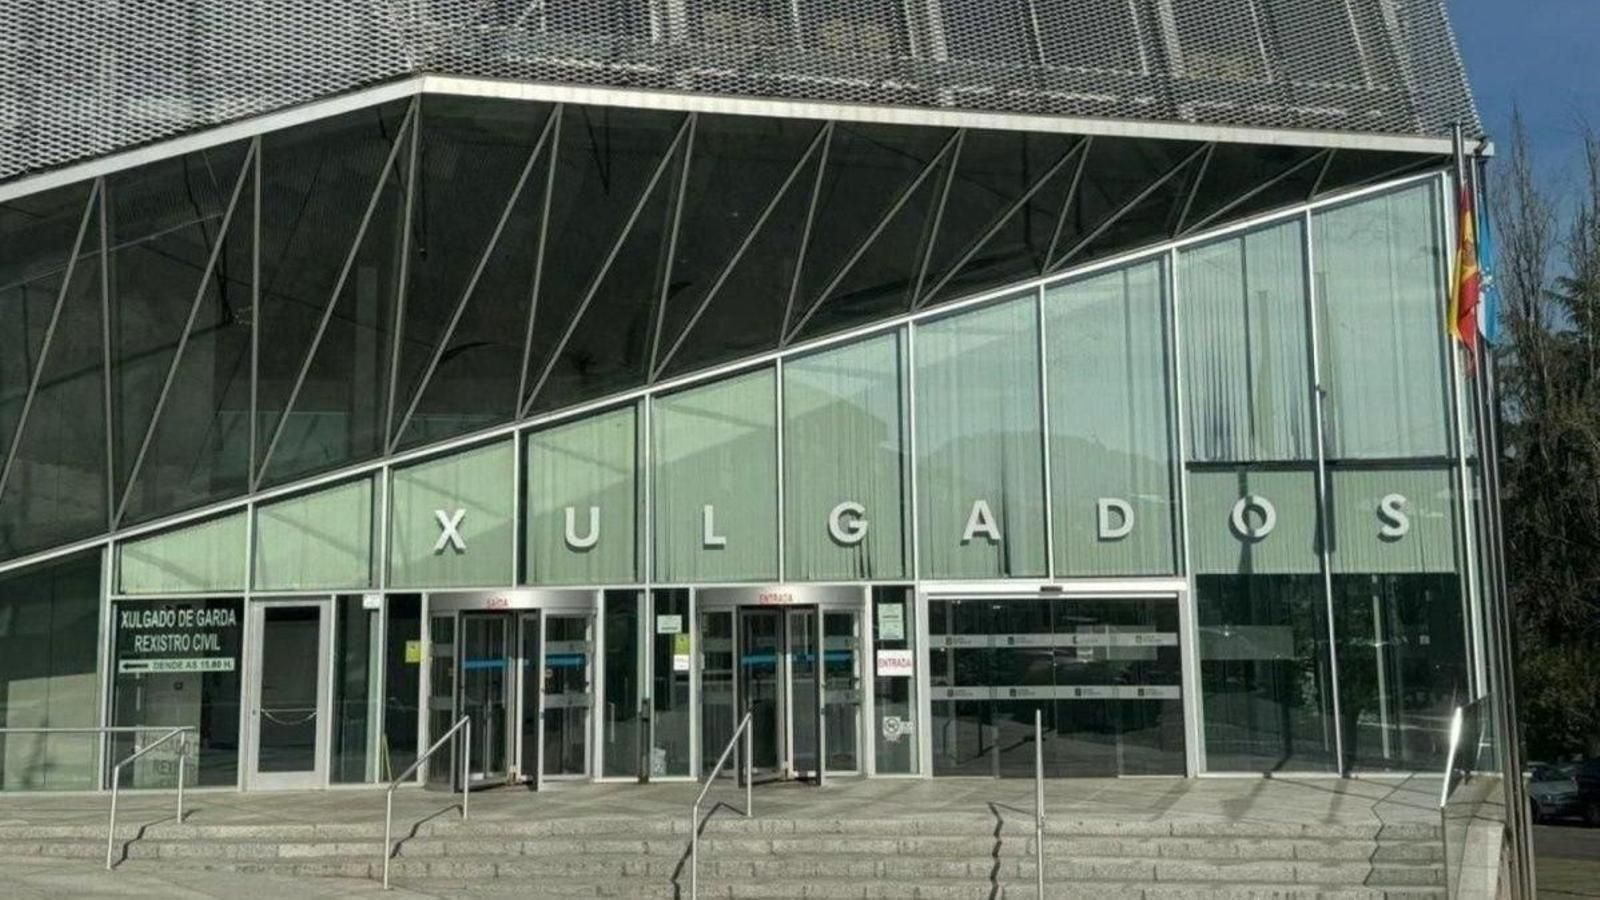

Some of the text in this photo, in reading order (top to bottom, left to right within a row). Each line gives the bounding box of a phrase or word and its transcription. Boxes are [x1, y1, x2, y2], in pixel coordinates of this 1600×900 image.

[434, 493, 1411, 552] XULGADOS
[121, 609, 236, 629] XULGADO DE GARDA
[135, 633, 220, 652] REXISTRO CIVIL
[878, 657, 912, 668] ENTRADA
